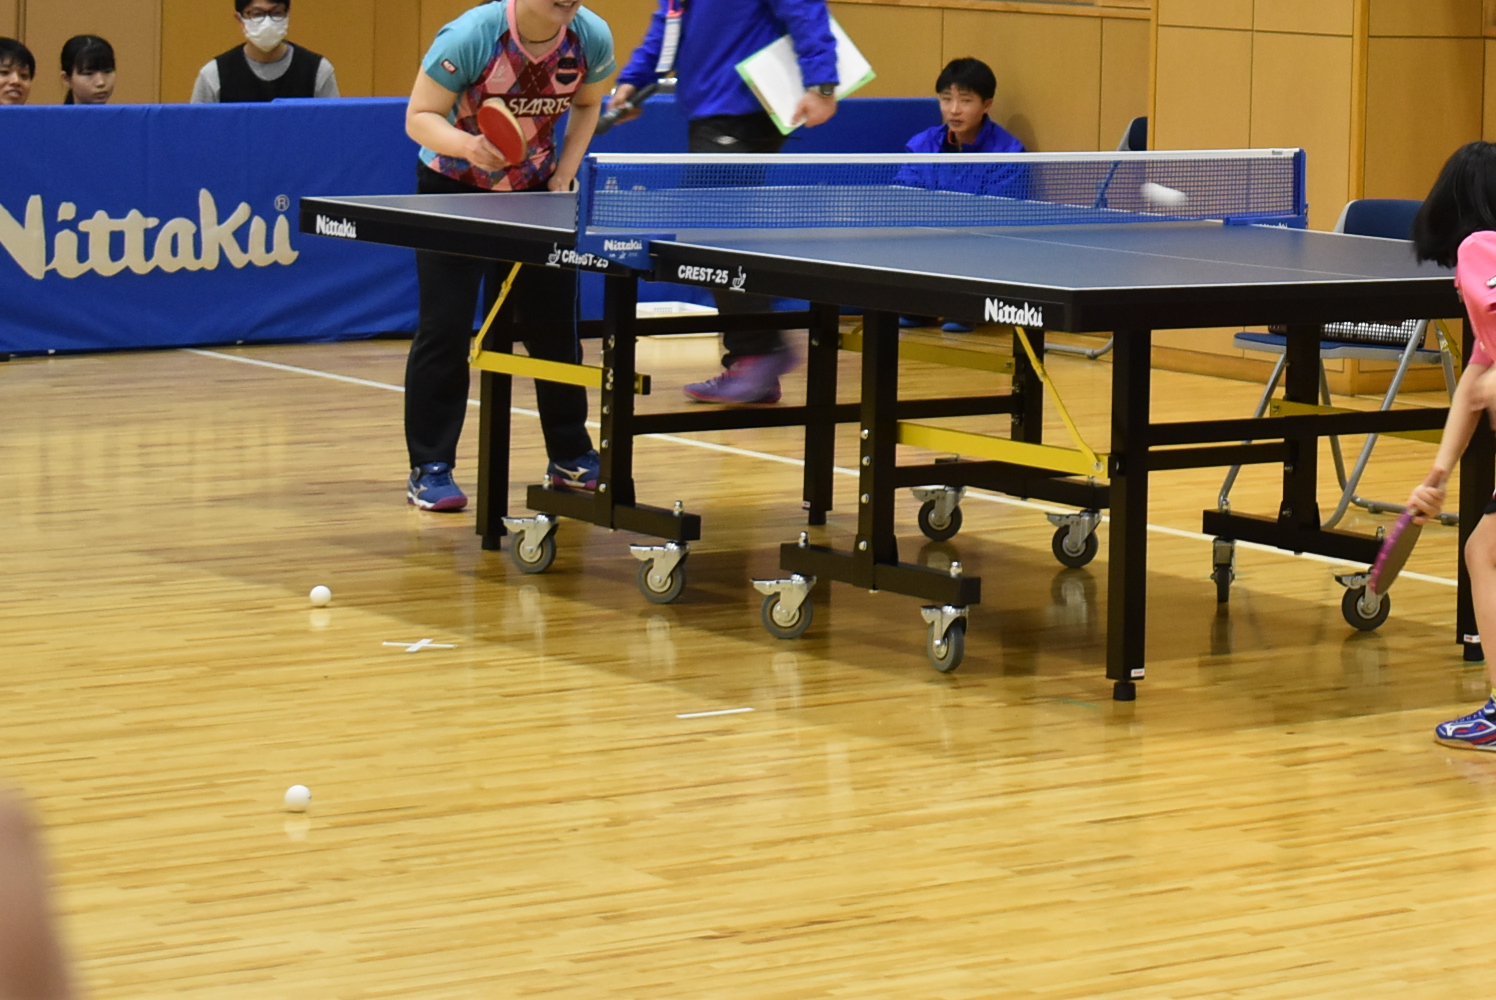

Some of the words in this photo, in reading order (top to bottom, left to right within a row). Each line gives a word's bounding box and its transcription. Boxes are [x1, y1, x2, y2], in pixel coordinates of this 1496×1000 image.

[0, 189, 299, 280] Nittaku
[315, 214, 357, 239] Nittaku
[604, 239, 643, 252] Nittaku
[678, 265, 729, 284] CREST-25
[984, 297, 1043, 328] Nittaku
